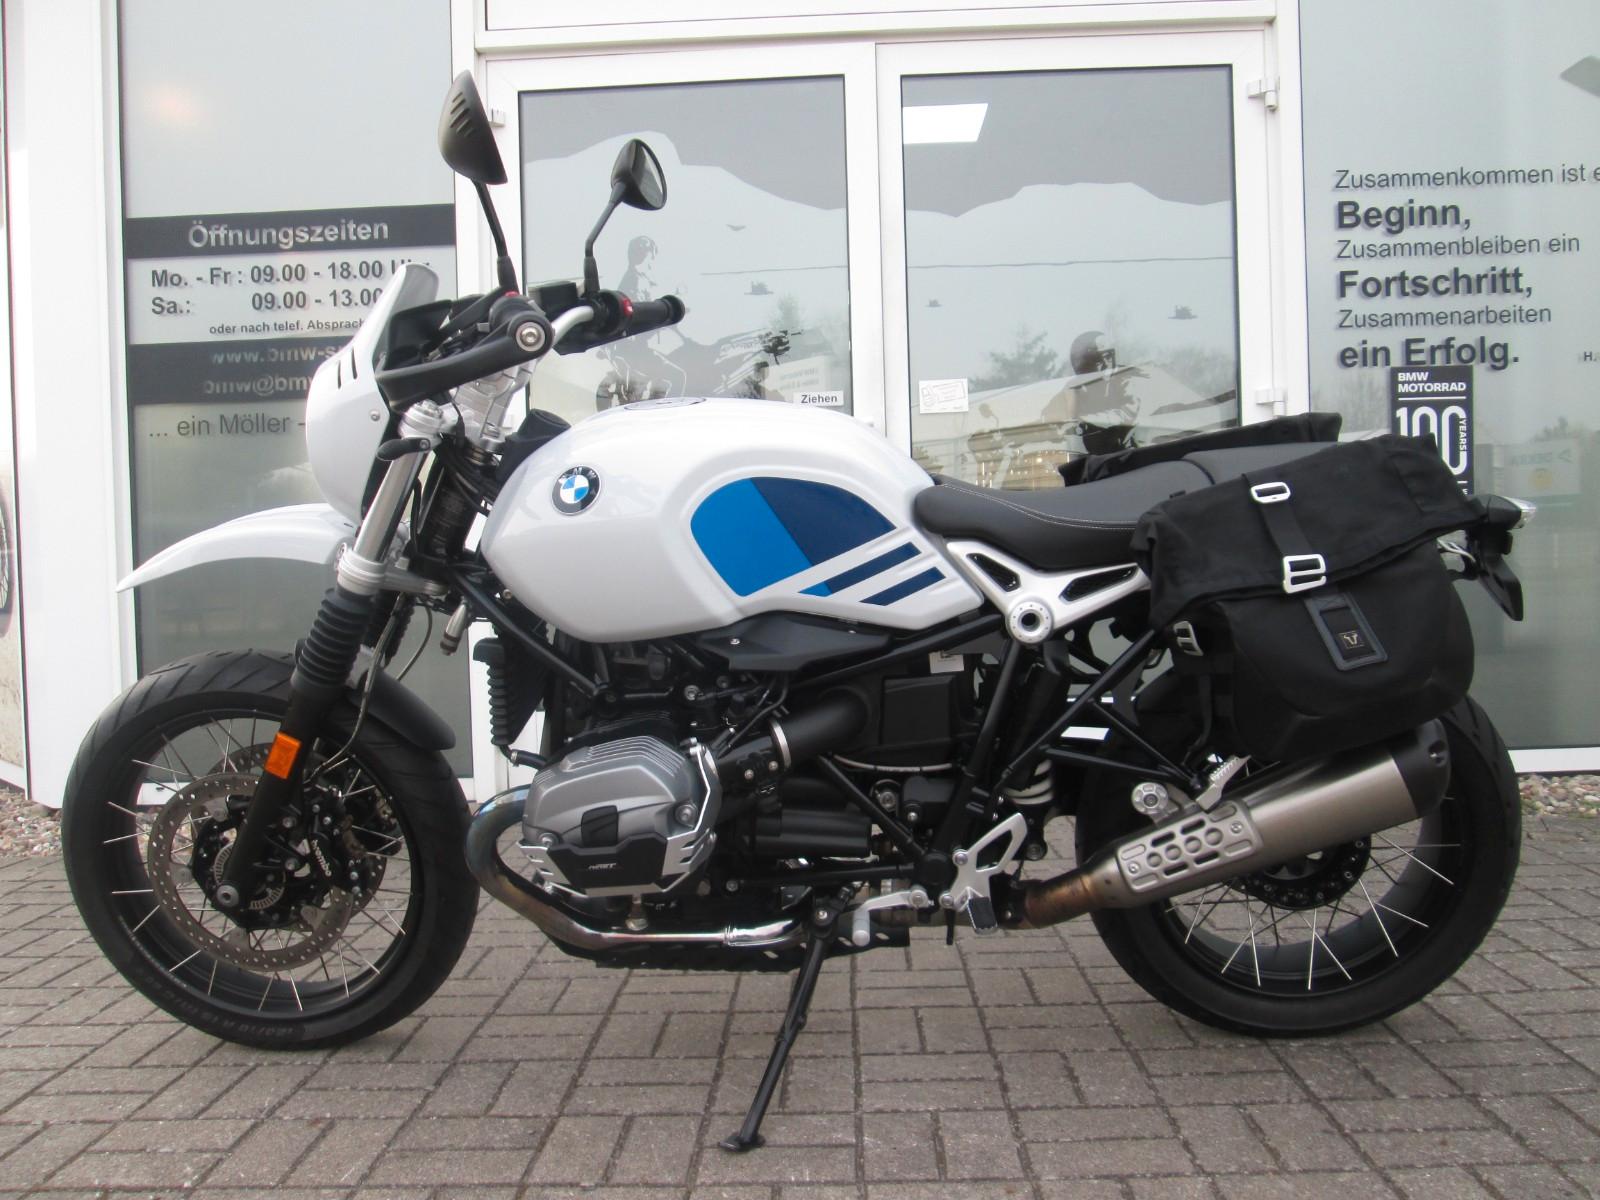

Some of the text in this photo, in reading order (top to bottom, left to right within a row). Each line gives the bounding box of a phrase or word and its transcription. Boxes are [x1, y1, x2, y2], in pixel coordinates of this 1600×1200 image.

[1335, 167, 1553, 189] Zusammenkommen
[1562, 164, 1586, 183] ist
[1337, 198, 1471, 234] Beginn,
[188, 220, 389, 249] Öffnungszeiten
[1336, 234, 1580, 259] Zusammenbleiben ein
[151, 269, 189, 288] Mo.
[250, 264, 305, 284] 09.00
[327, 260, 383, 280] 18.00
[1338, 266, 1533, 298] Fortschritt,
[151, 296, 191, 315] Sa.:
[251, 291, 307, 311] 09.00
[209, 323, 236, 335] oder
[240, 322, 270, 334] nach
[273, 320, 304, 332] telef.
[1337, 305, 1552, 329] Zusammenarbeiten
[1340, 339, 1391, 368] ein
[1404, 336, 1519, 370] Erfolg.
[1398, 372, 1429, 382] BMW
[1398, 382, 1467, 393] MOTORRAD
[800, 394, 838, 404] Ziehen
[177, 416, 210, 436] ein
[220, 407, 290, 434] Möller
[1459, 418, 1468, 451] YEARS
